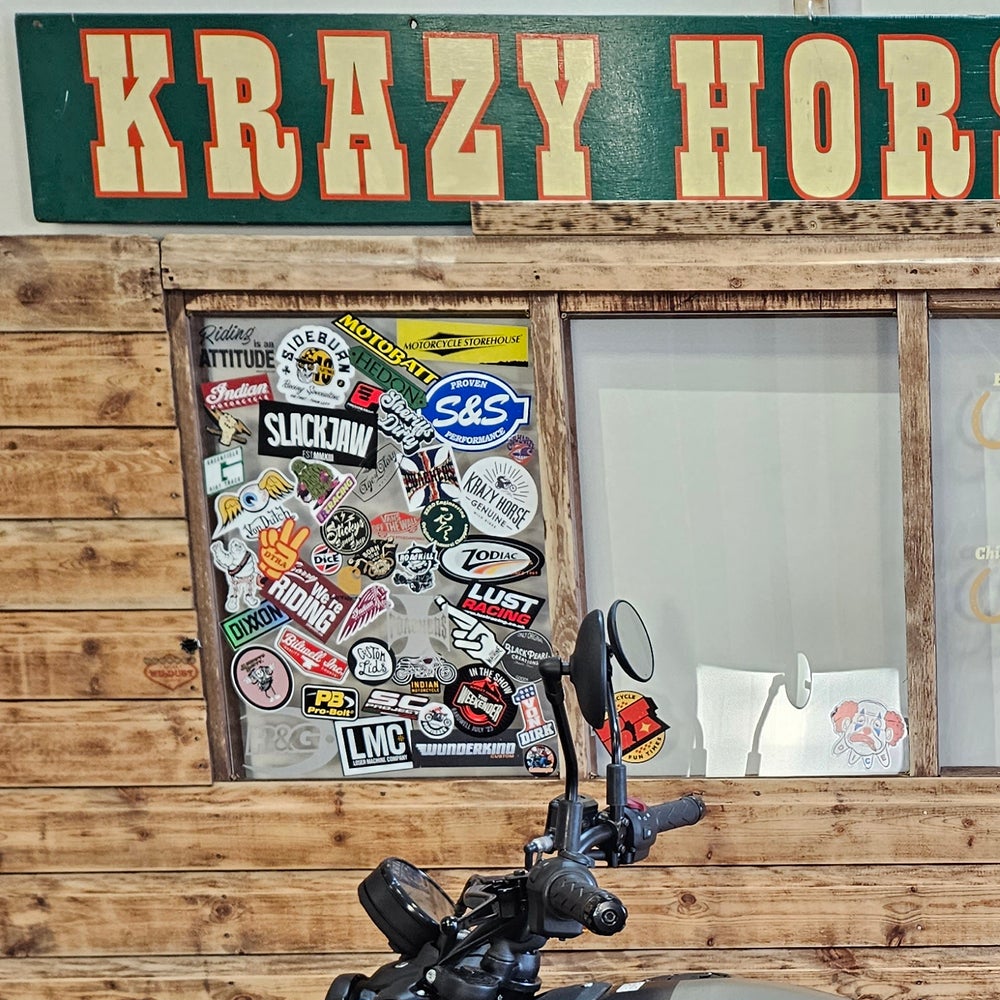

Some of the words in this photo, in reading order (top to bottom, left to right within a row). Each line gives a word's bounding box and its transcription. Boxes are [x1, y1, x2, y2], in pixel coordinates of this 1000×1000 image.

[80, 28, 600, 201] KRAZY
[200, 323, 255, 345] Riding
[404, 339, 462, 350] MOTORCYCLE
[464, 335, 521, 346] STOREHOUSE
[200, 349, 275, 368] ATTITUDE
[282, 330, 350, 373] SIDEBURN
[338, 314, 439, 384] MOTOBATT
[206, 382, 269, 404] Indian
[451, 379, 488, 390] PROVEN
[433, 394, 510, 428] S&S
[264, 412, 373, 458] SLACKJAW
[444, 427, 506, 445] PERFORMANCE
[463, 472, 499, 503] KRAZY
[495, 494, 531, 531] HORSE
[470, 500, 507, 528] GENUINE
[264, 550, 287, 569] DTRA
[462, 549, 519, 571] ZODIAC
[268, 575, 337, 634] RIDING
[311, 581, 344, 614] We're
[468, 583, 539, 612] LUST
[229, 604, 283, 640] DIXXON
[461, 598, 532, 625] RACING
[411, 680, 439, 688] INDIAN
[469, 667, 478, 677] IN
[479, 667, 494, 678] THE
[493, 673, 513, 694] SHOW
[307, 706, 352, 718] Pro-Bolt
[315, 689, 345, 708] PB
[367, 690, 429, 711] SC
[457, 685, 503, 722] WEEKENDER
[347, 723, 406, 760] LMC
[519, 725, 554, 746] DIRK
